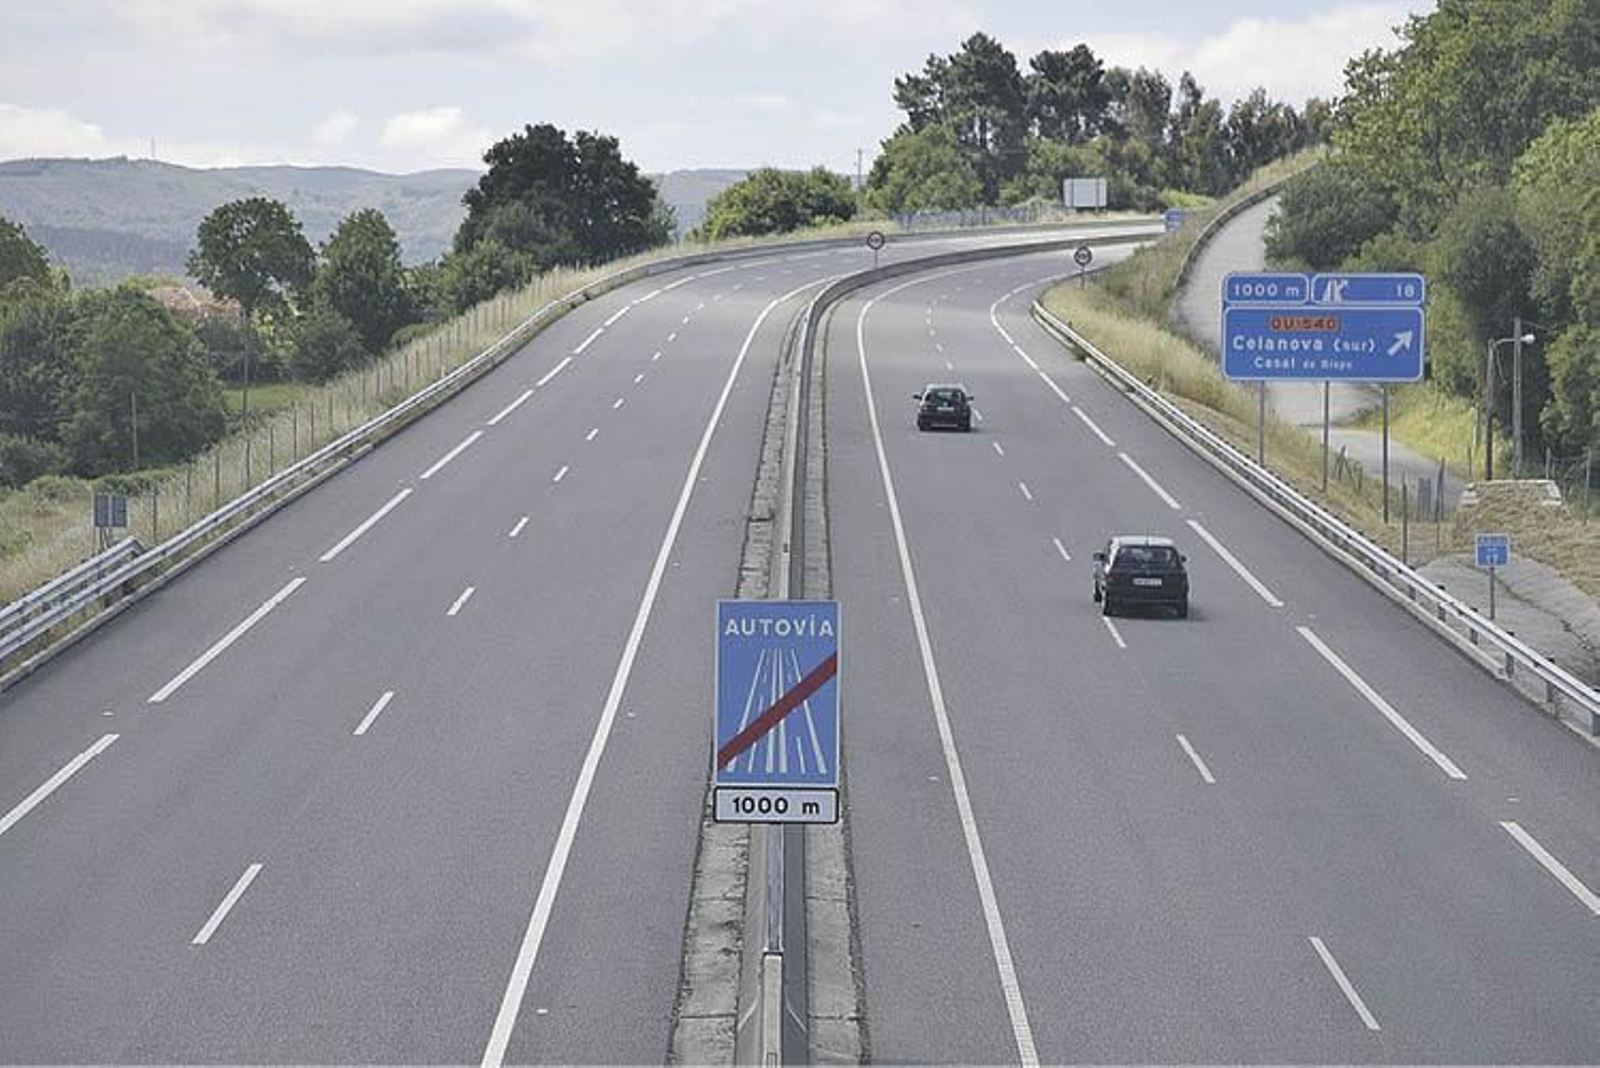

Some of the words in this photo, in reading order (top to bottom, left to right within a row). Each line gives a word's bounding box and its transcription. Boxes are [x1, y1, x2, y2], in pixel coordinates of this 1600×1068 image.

[1234, 283, 1278, 297] 1000
[1285, 286, 1300, 297] m
[1397, 284, 1415, 298] 18
[1233, 335, 1323, 351] Celanova
[1333, 338, 1376, 353] (sur)
[724, 614, 835, 637] AUTOVÍA
[732, 796, 789, 815] 1000
[801, 800, 820, 815] m
